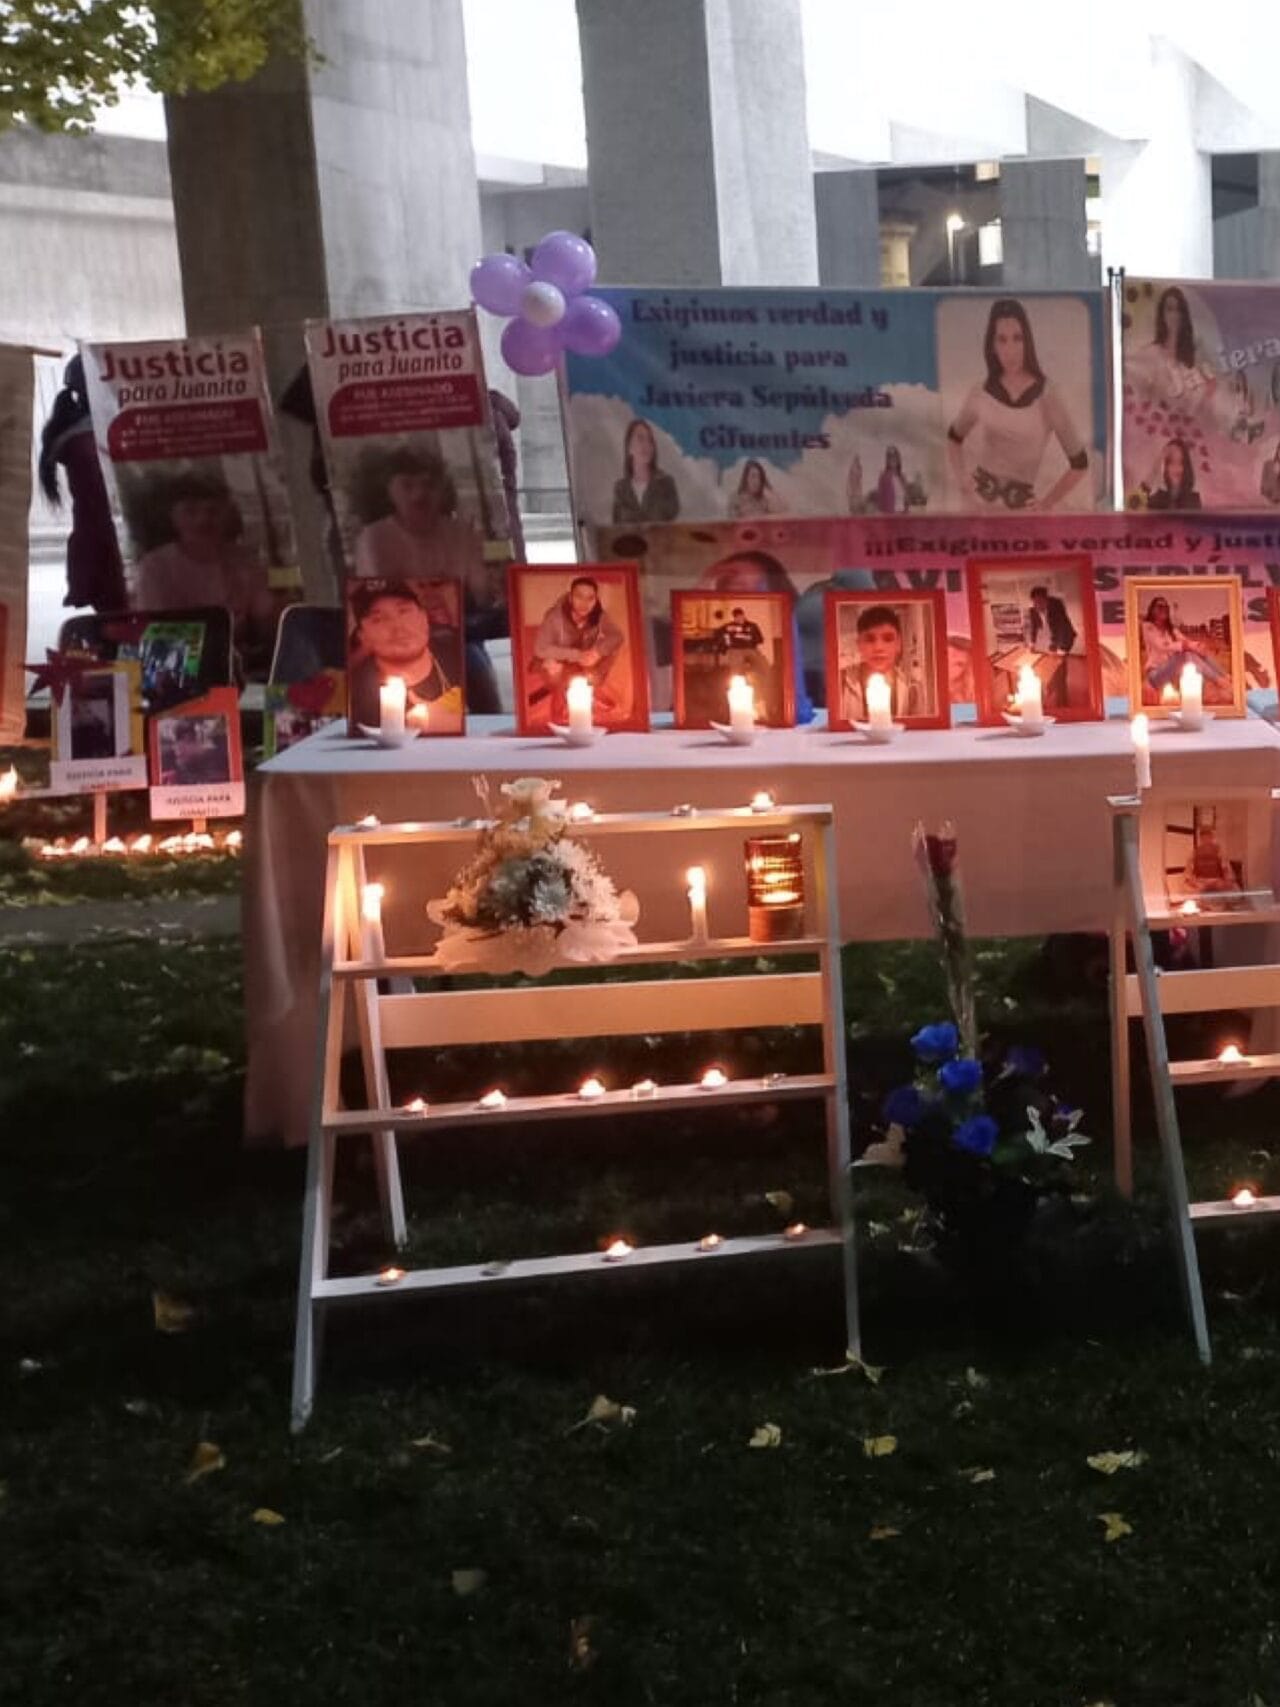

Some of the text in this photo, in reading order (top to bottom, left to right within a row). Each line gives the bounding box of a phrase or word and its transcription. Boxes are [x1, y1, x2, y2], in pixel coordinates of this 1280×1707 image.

[631, 298, 890, 331] Exigimos verdad y
[322, 318, 465, 358] Justicia
[100, 344, 249, 381] Justicia
[338, 352, 462, 383] para Juanito
[670, 340, 848, 373] justicia para
[118, 377, 246, 408] para Juanito
[639, 382, 894, 415] Javiera Sepúlveda
[699, 424, 831, 450] Cifuentes
[1061, 531, 1172, 550] verdad
[1185, 534, 1201, 551] y
